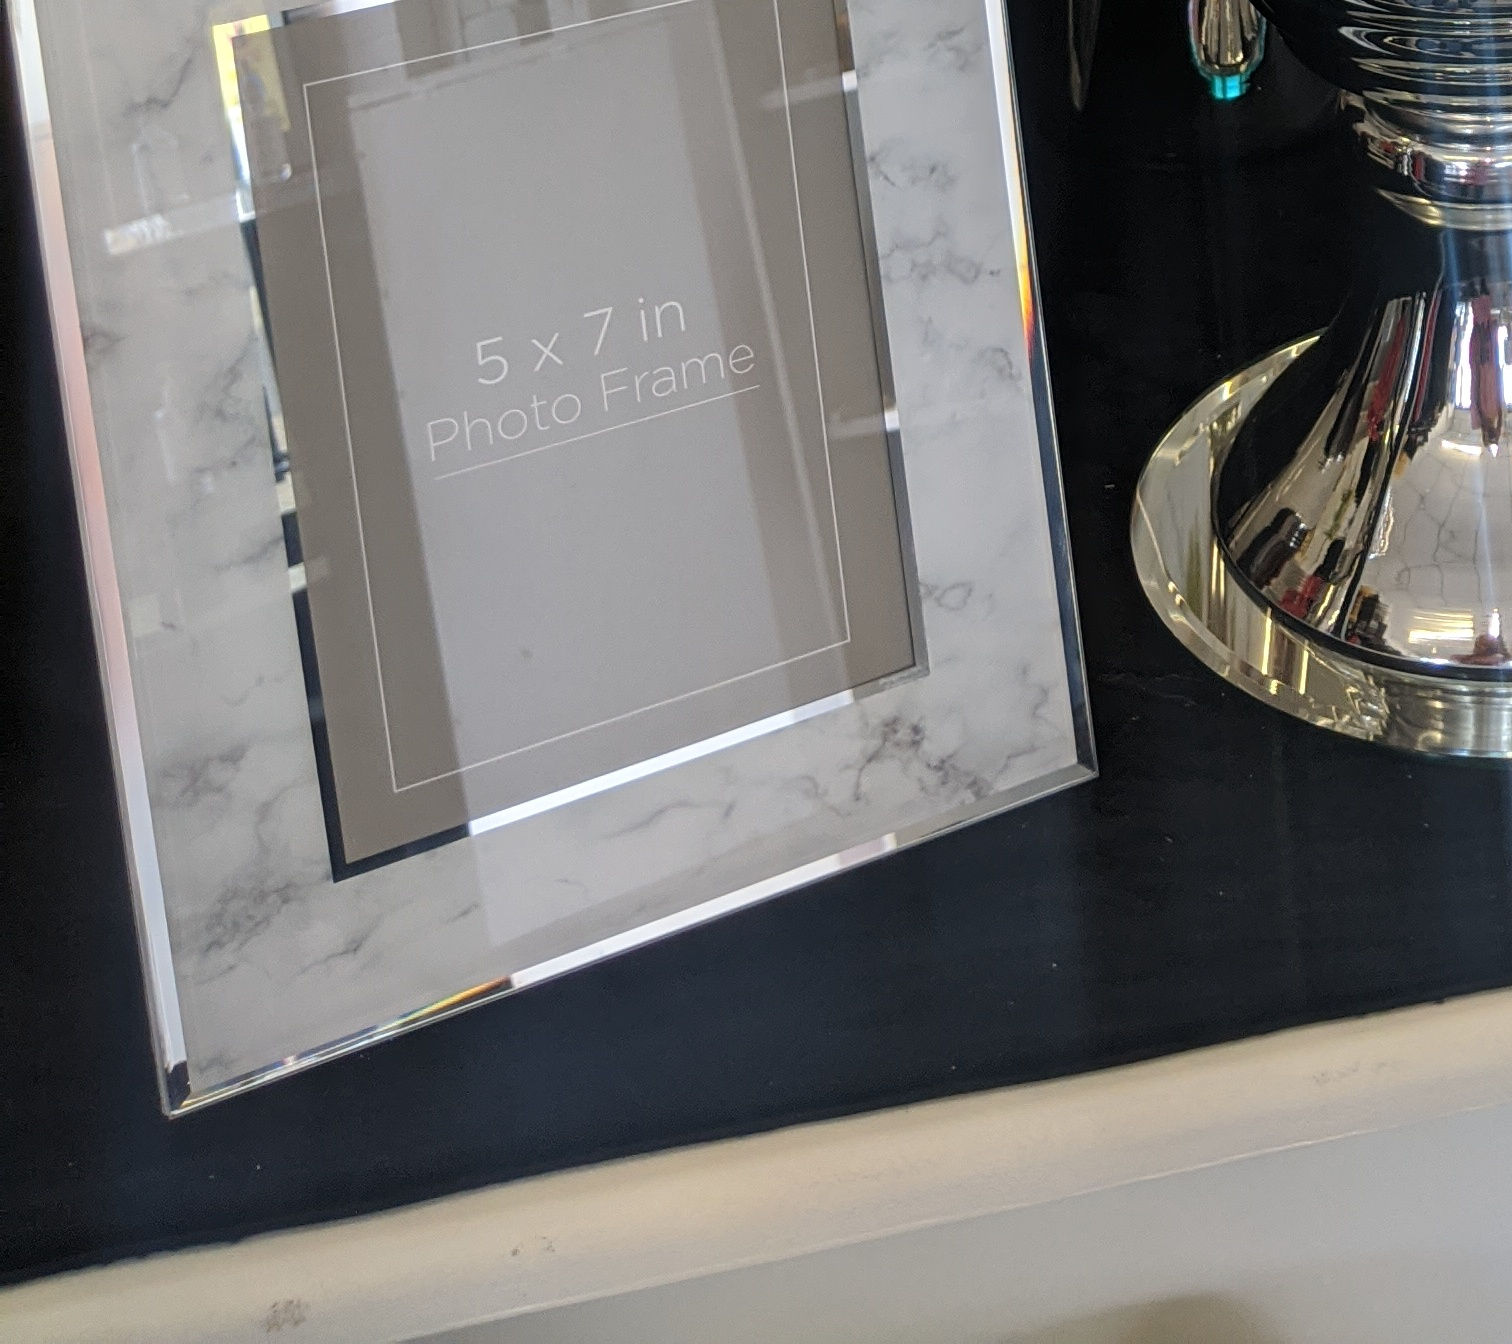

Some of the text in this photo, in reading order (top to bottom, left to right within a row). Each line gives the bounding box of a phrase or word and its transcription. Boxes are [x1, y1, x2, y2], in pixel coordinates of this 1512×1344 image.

[475, 296, 686, 385] 5 x 7 in
[425, 343, 755, 462] Photo Frame
